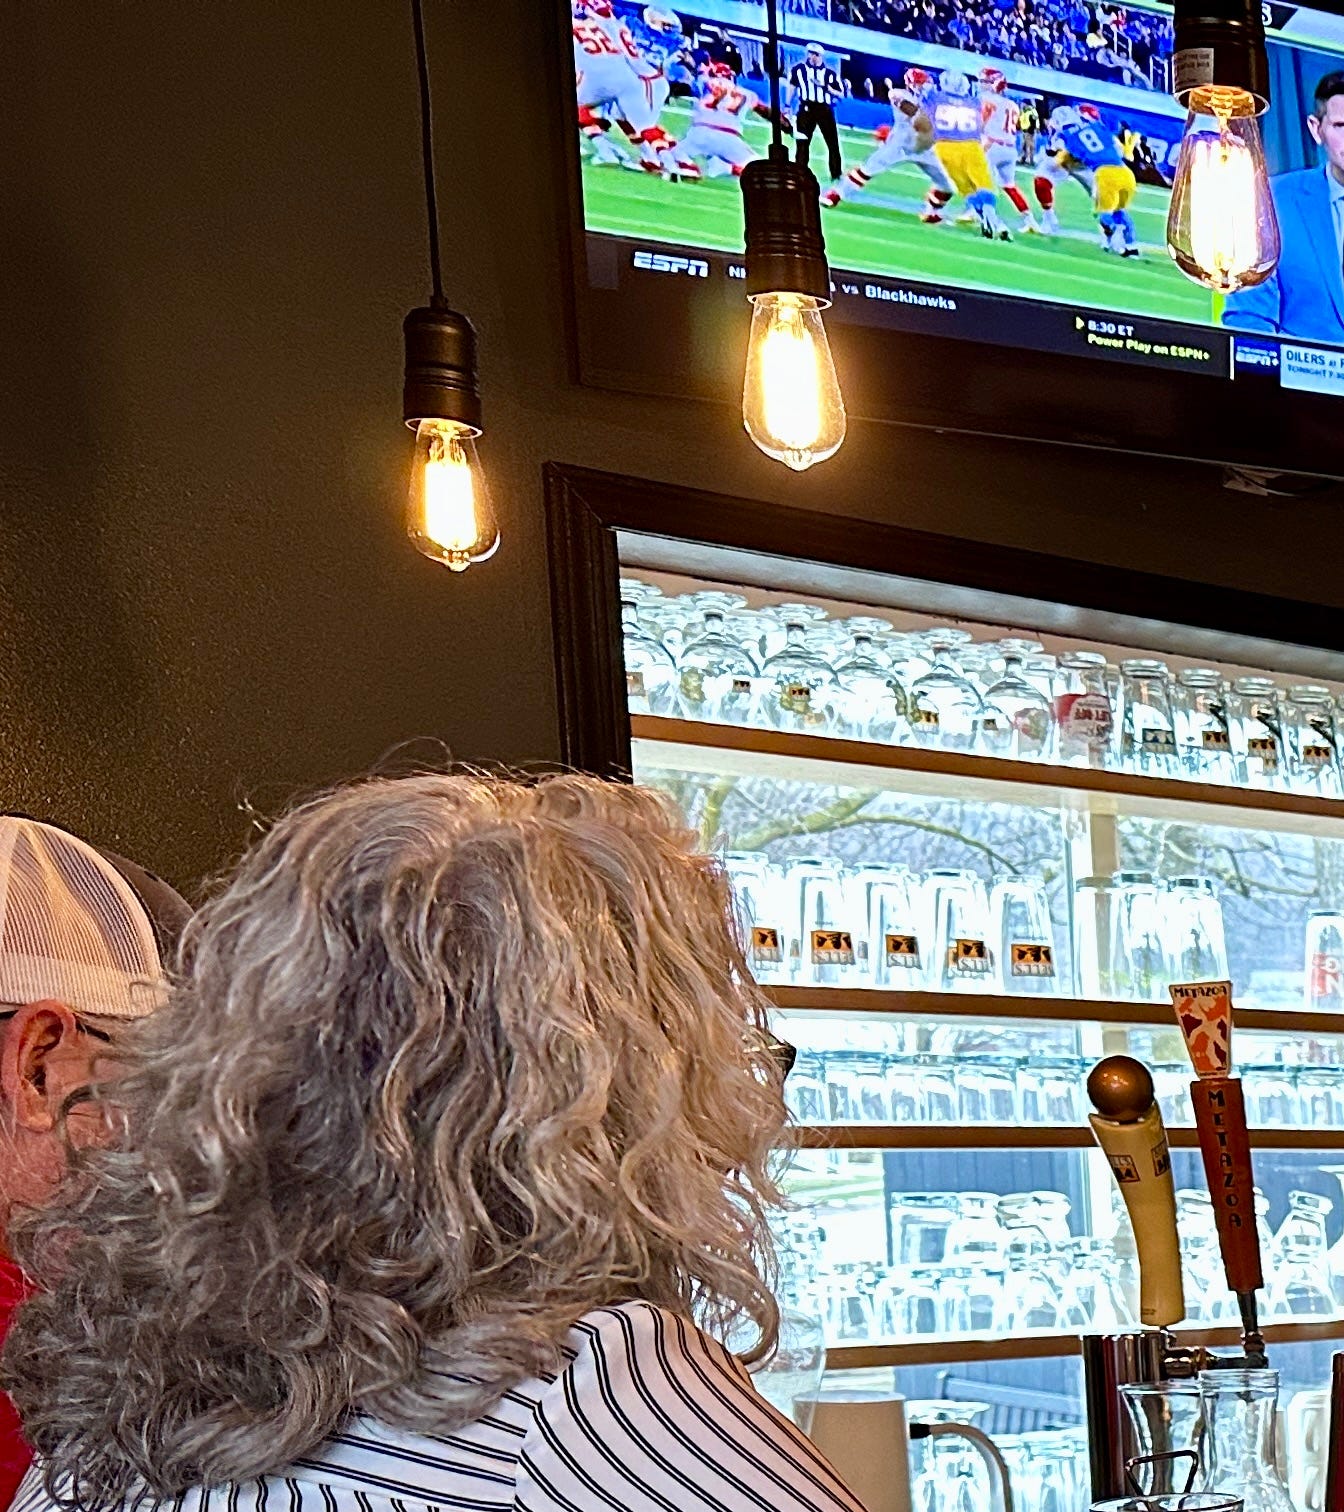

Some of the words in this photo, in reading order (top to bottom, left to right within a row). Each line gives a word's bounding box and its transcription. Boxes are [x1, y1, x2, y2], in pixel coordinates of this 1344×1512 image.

[633, 250, 709, 278] ESPN
[842, 283, 859, 296] vs
[865, 284, 957, 311] Blackhawks
[1117, 323, 1134, 337] ET
[1087, 332, 1125, 351] Power
[1126, 338, 1151, 357] Play
[1153, 344, 1168, 356] on
[1170, 346, 1211, 363] ESPN+
[1286, 349, 1326, 366] OILERS
[1173, 985, 1228, 999] METAZOA
[1208, 1089, 1242, 1228] METAZOA
